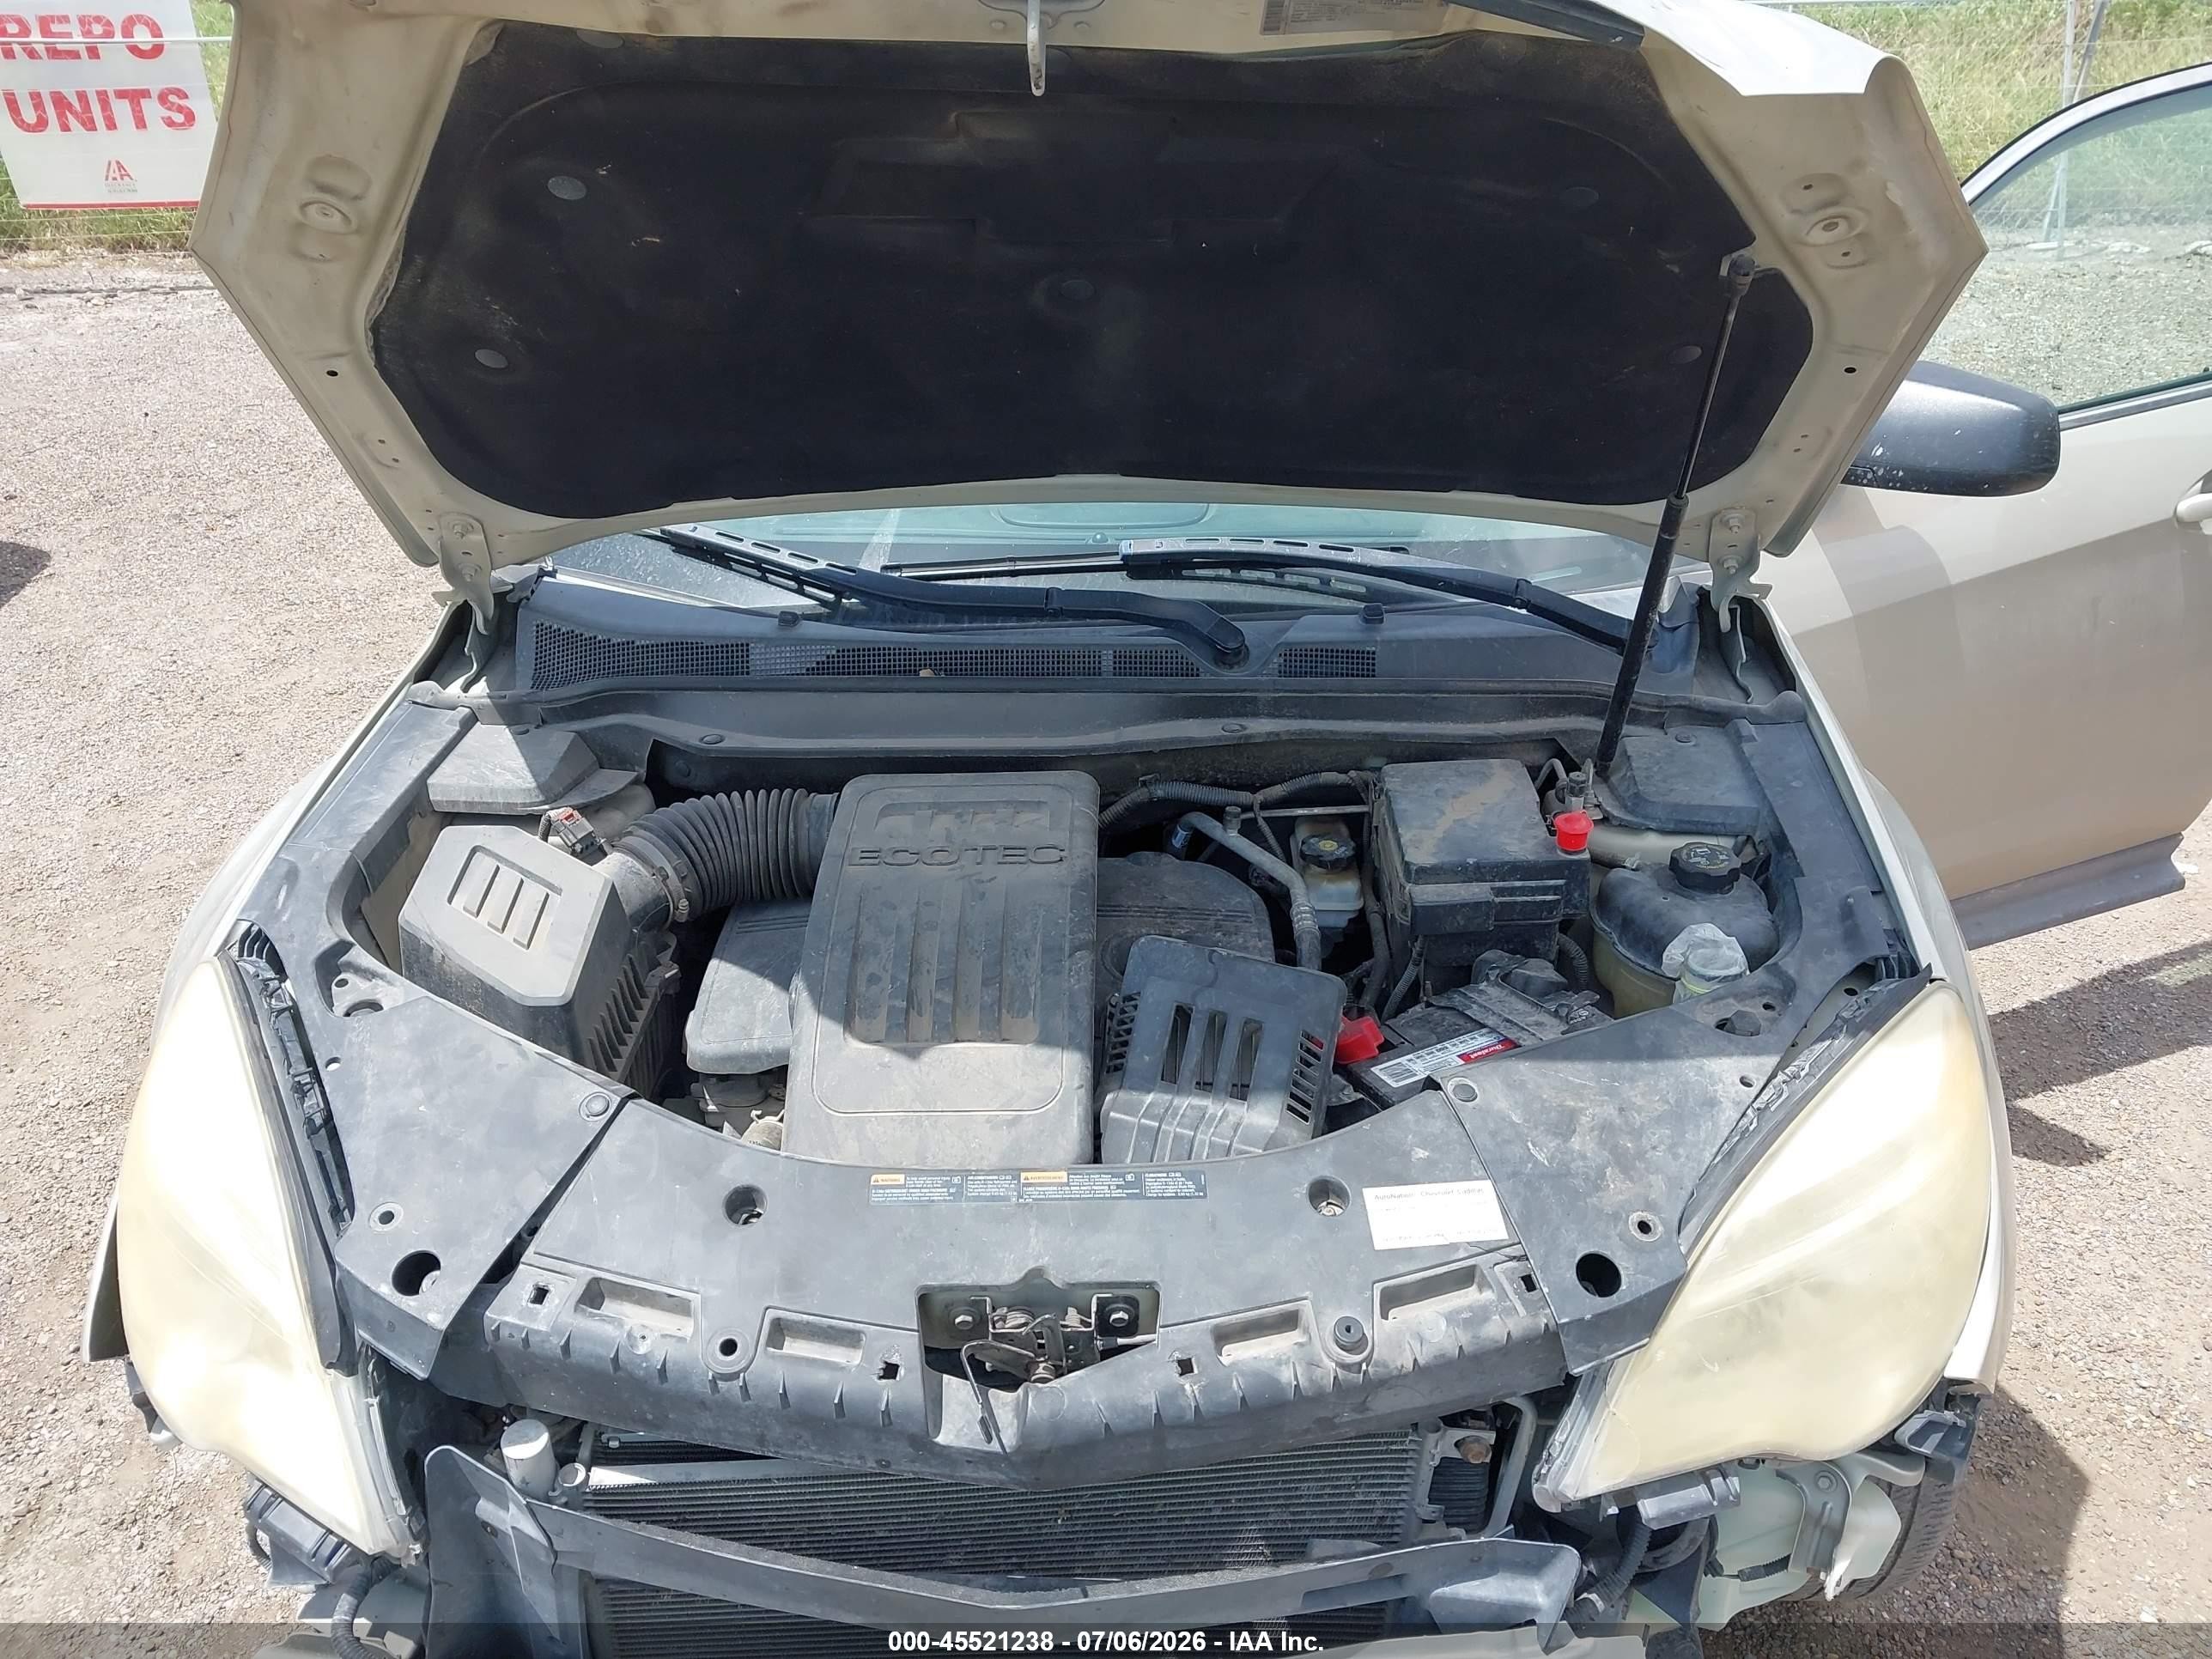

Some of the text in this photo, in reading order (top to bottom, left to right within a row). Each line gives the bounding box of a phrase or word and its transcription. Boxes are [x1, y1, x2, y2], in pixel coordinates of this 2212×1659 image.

[0, 14, 165, 60] REPO
[3, 87, 196, 133] UNITS
[847, 845, 1066, 866] ECOTEC
